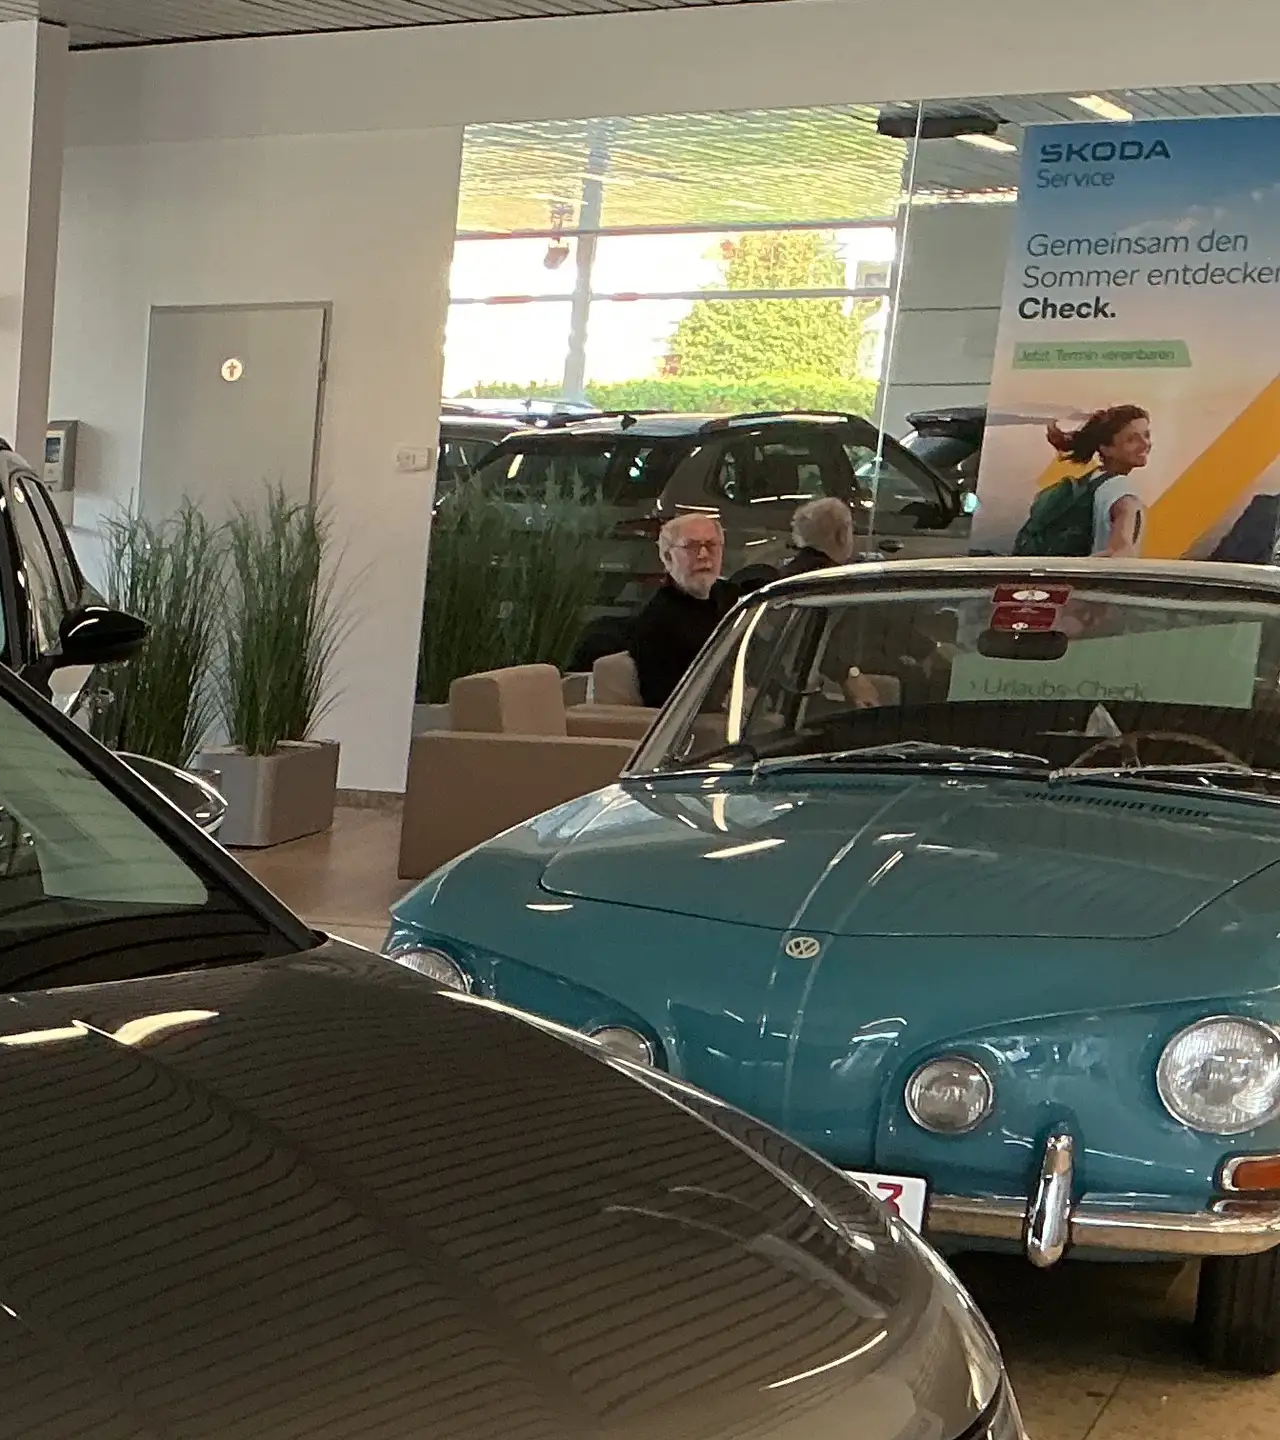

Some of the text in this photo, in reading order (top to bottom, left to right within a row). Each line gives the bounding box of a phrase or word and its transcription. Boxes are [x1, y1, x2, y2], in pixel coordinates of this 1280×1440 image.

[1036, 168, 1116, 189] Service
[1027, 228, 1248, 257] Gemeinsam den
[1023, 264, 1140, 289] Sommer
[1018, 296, 1116, 320] Check.
